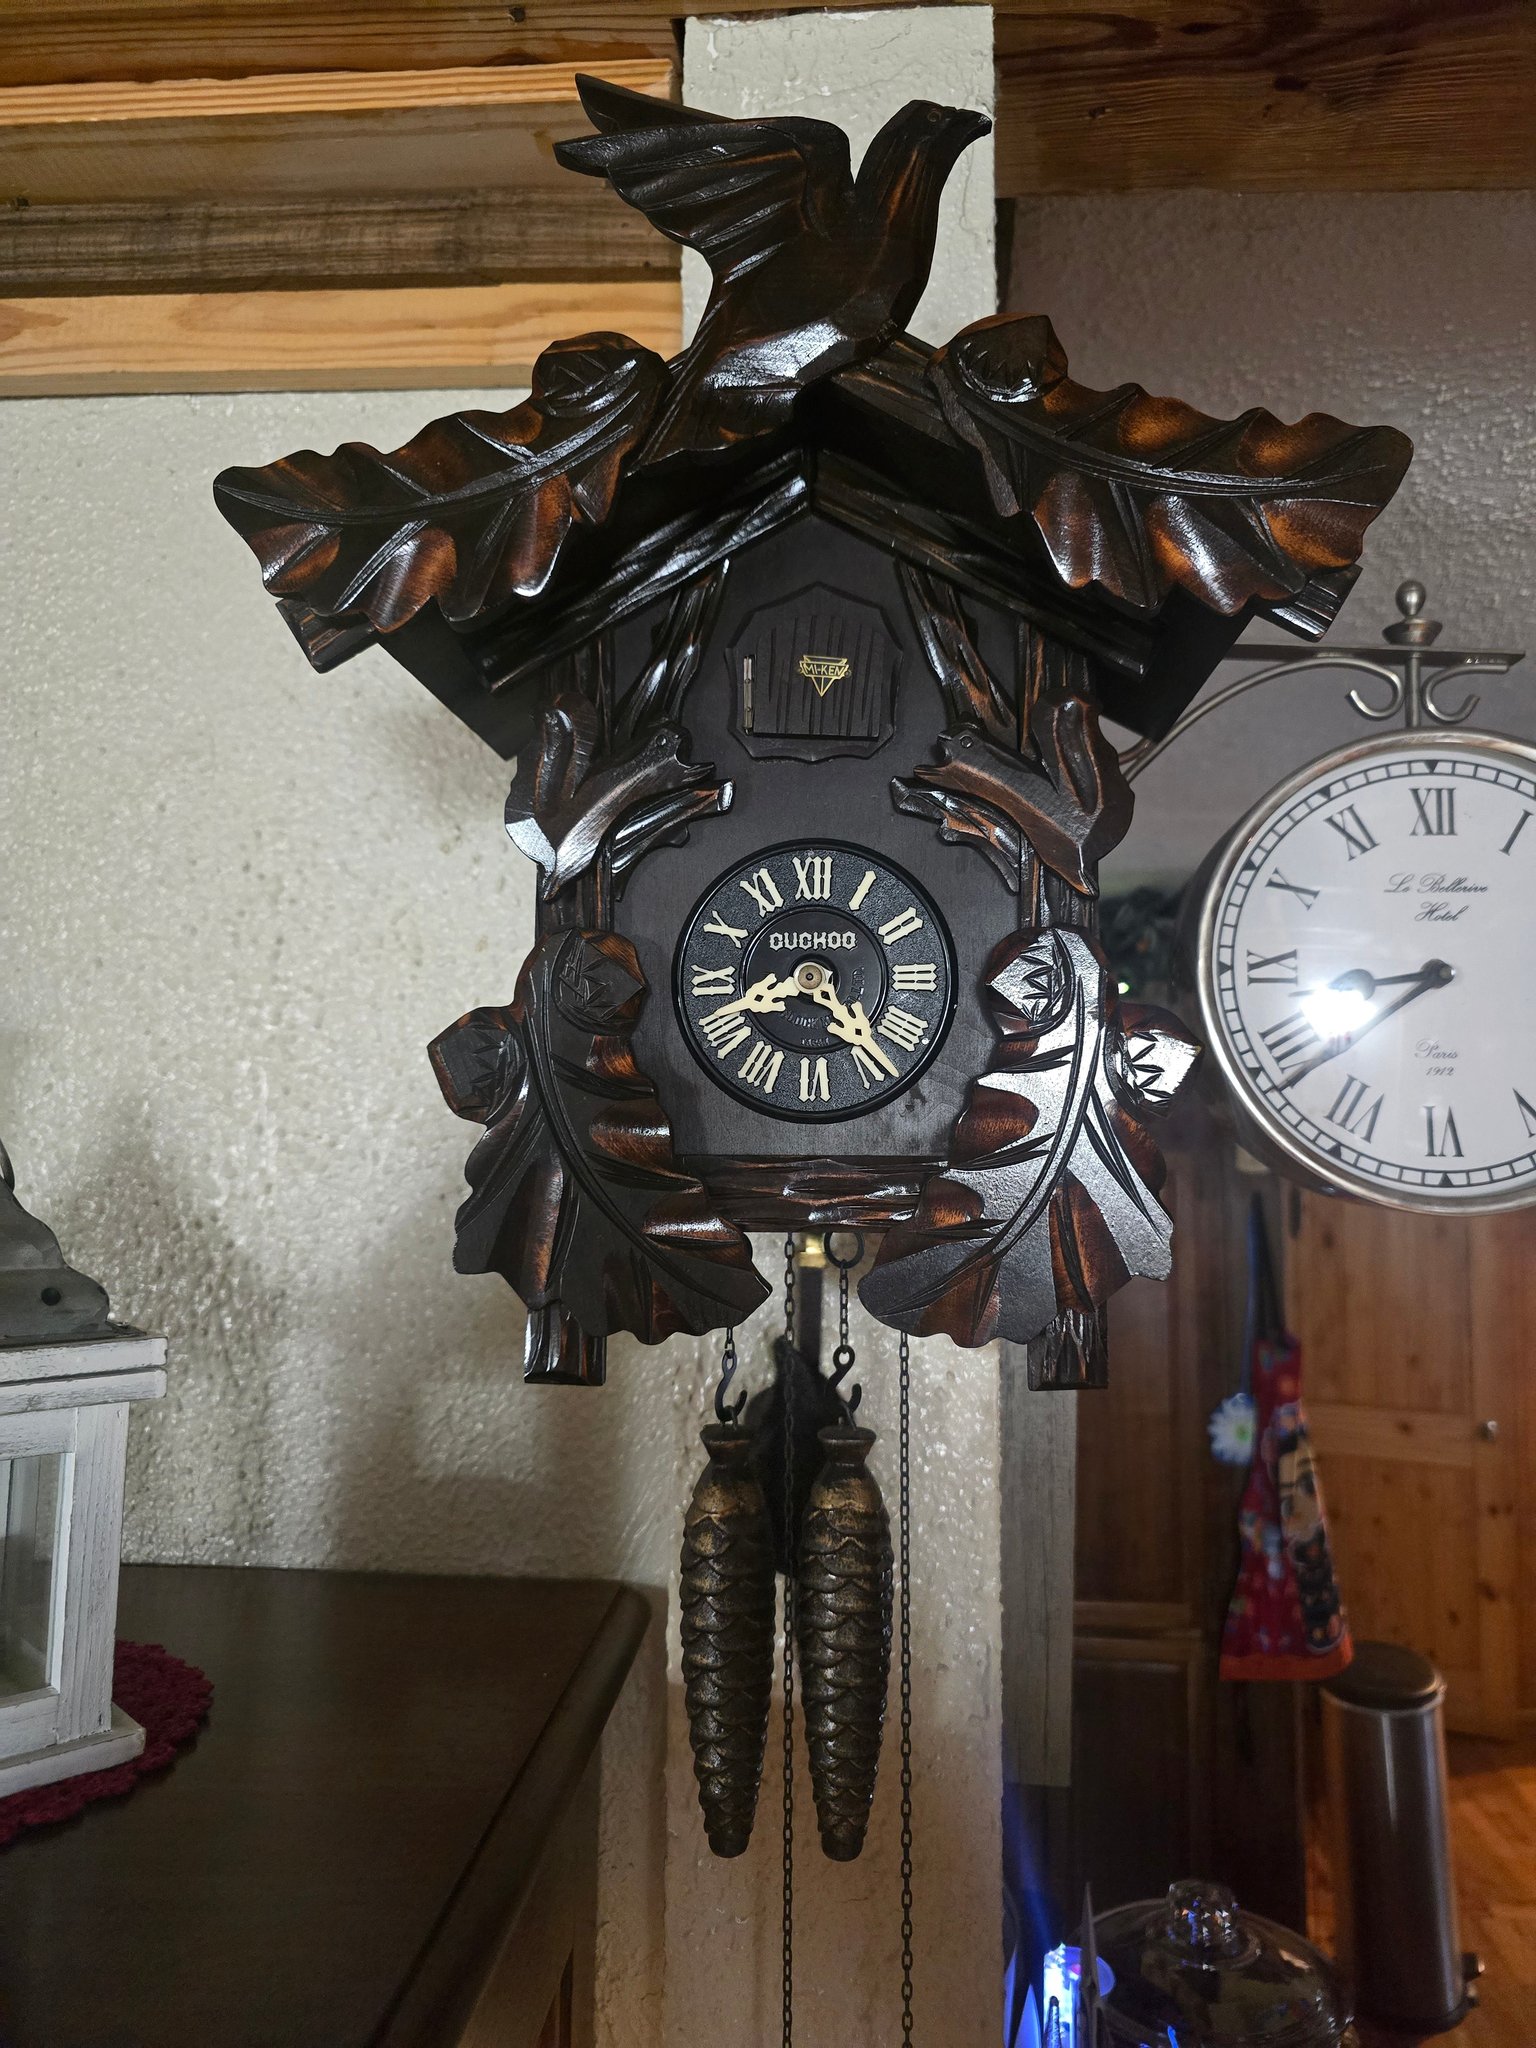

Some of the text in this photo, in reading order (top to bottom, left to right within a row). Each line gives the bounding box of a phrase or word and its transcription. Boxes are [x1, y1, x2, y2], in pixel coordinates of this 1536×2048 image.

[803, 663, 845, 676] MI-KEN
[1324, 804, 1379, 861] XI
[1409, 788, 1456, 836] XII
[1499, 808, 1534, 855] I
[740, 868, 784, 918] XI
[792, 856, 833, 901] XII
[848, 870, 877, 911] I
[1266, 867, 1321, 910] X
[1417, 872, 1488, 893] Bellerive
[703, 910, 749, 948] X
[877, 906, 924, 946] II
[1414, 901, 1470, 921] Hotel
[769, 930, 857, 951] CUCKOO
[691, 964, 736, 997] IX
[892, 963, 938, 991] III
[1247, 949, 1299, 985] IX
[876, 1005, 928, 1052] IIII
[1414, 1038, 1458, 1058] Paris
[738, 1040, 785, 1094] VII
[798, 1056, 831, 1102] VI
[851, 1046, 885, 1089] V
[1425, 1065, 1455, 1076] 1912
[1323, 1073, 1385, 1143] VII
[1423, 1106, 1464, 1157] VI
